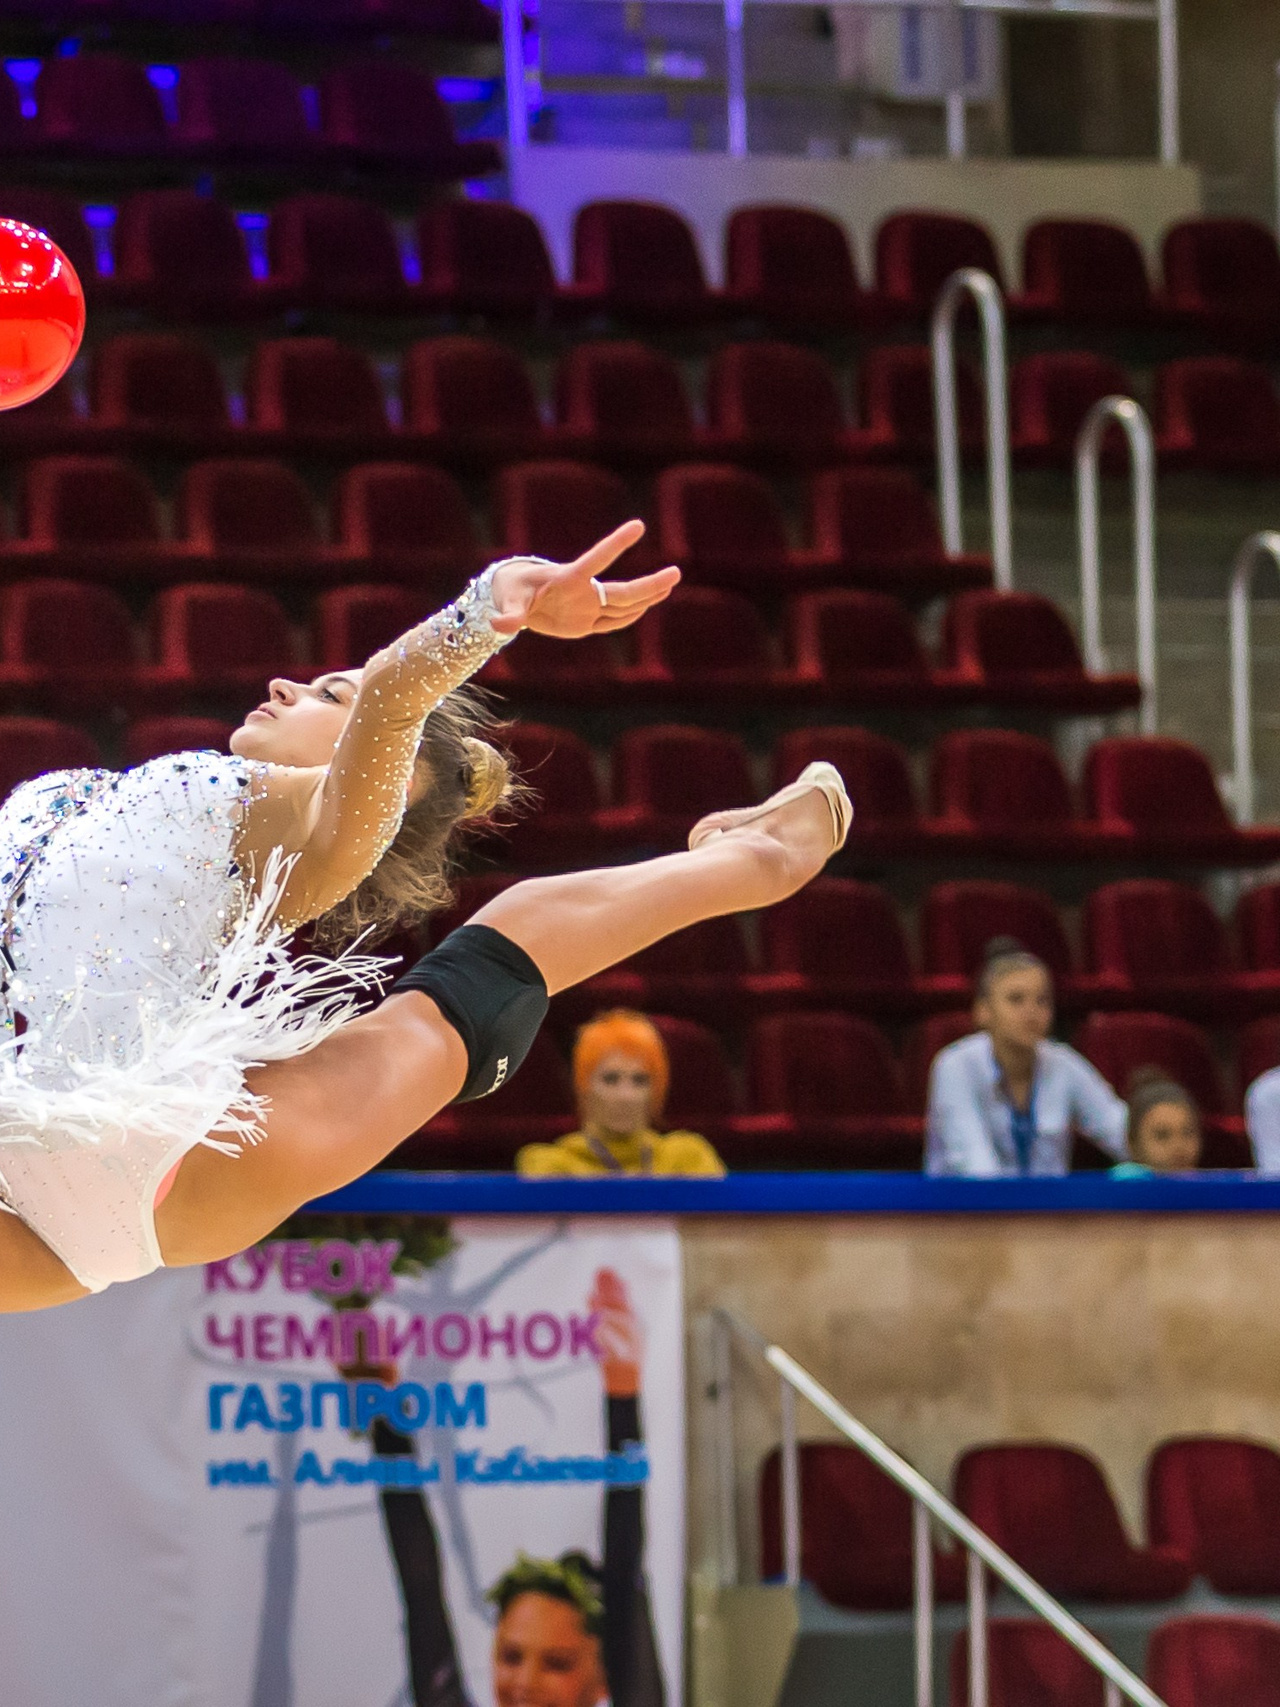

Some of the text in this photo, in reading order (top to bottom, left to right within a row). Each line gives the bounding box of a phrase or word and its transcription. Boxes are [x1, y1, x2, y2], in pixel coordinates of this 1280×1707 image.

[204, 1239, 400, 1293] КУБОК
[205, 1311, 603, 1362] ЧЕМПИОНОК
[207, 1381, 487, 1431] ГАЗПРОМ
